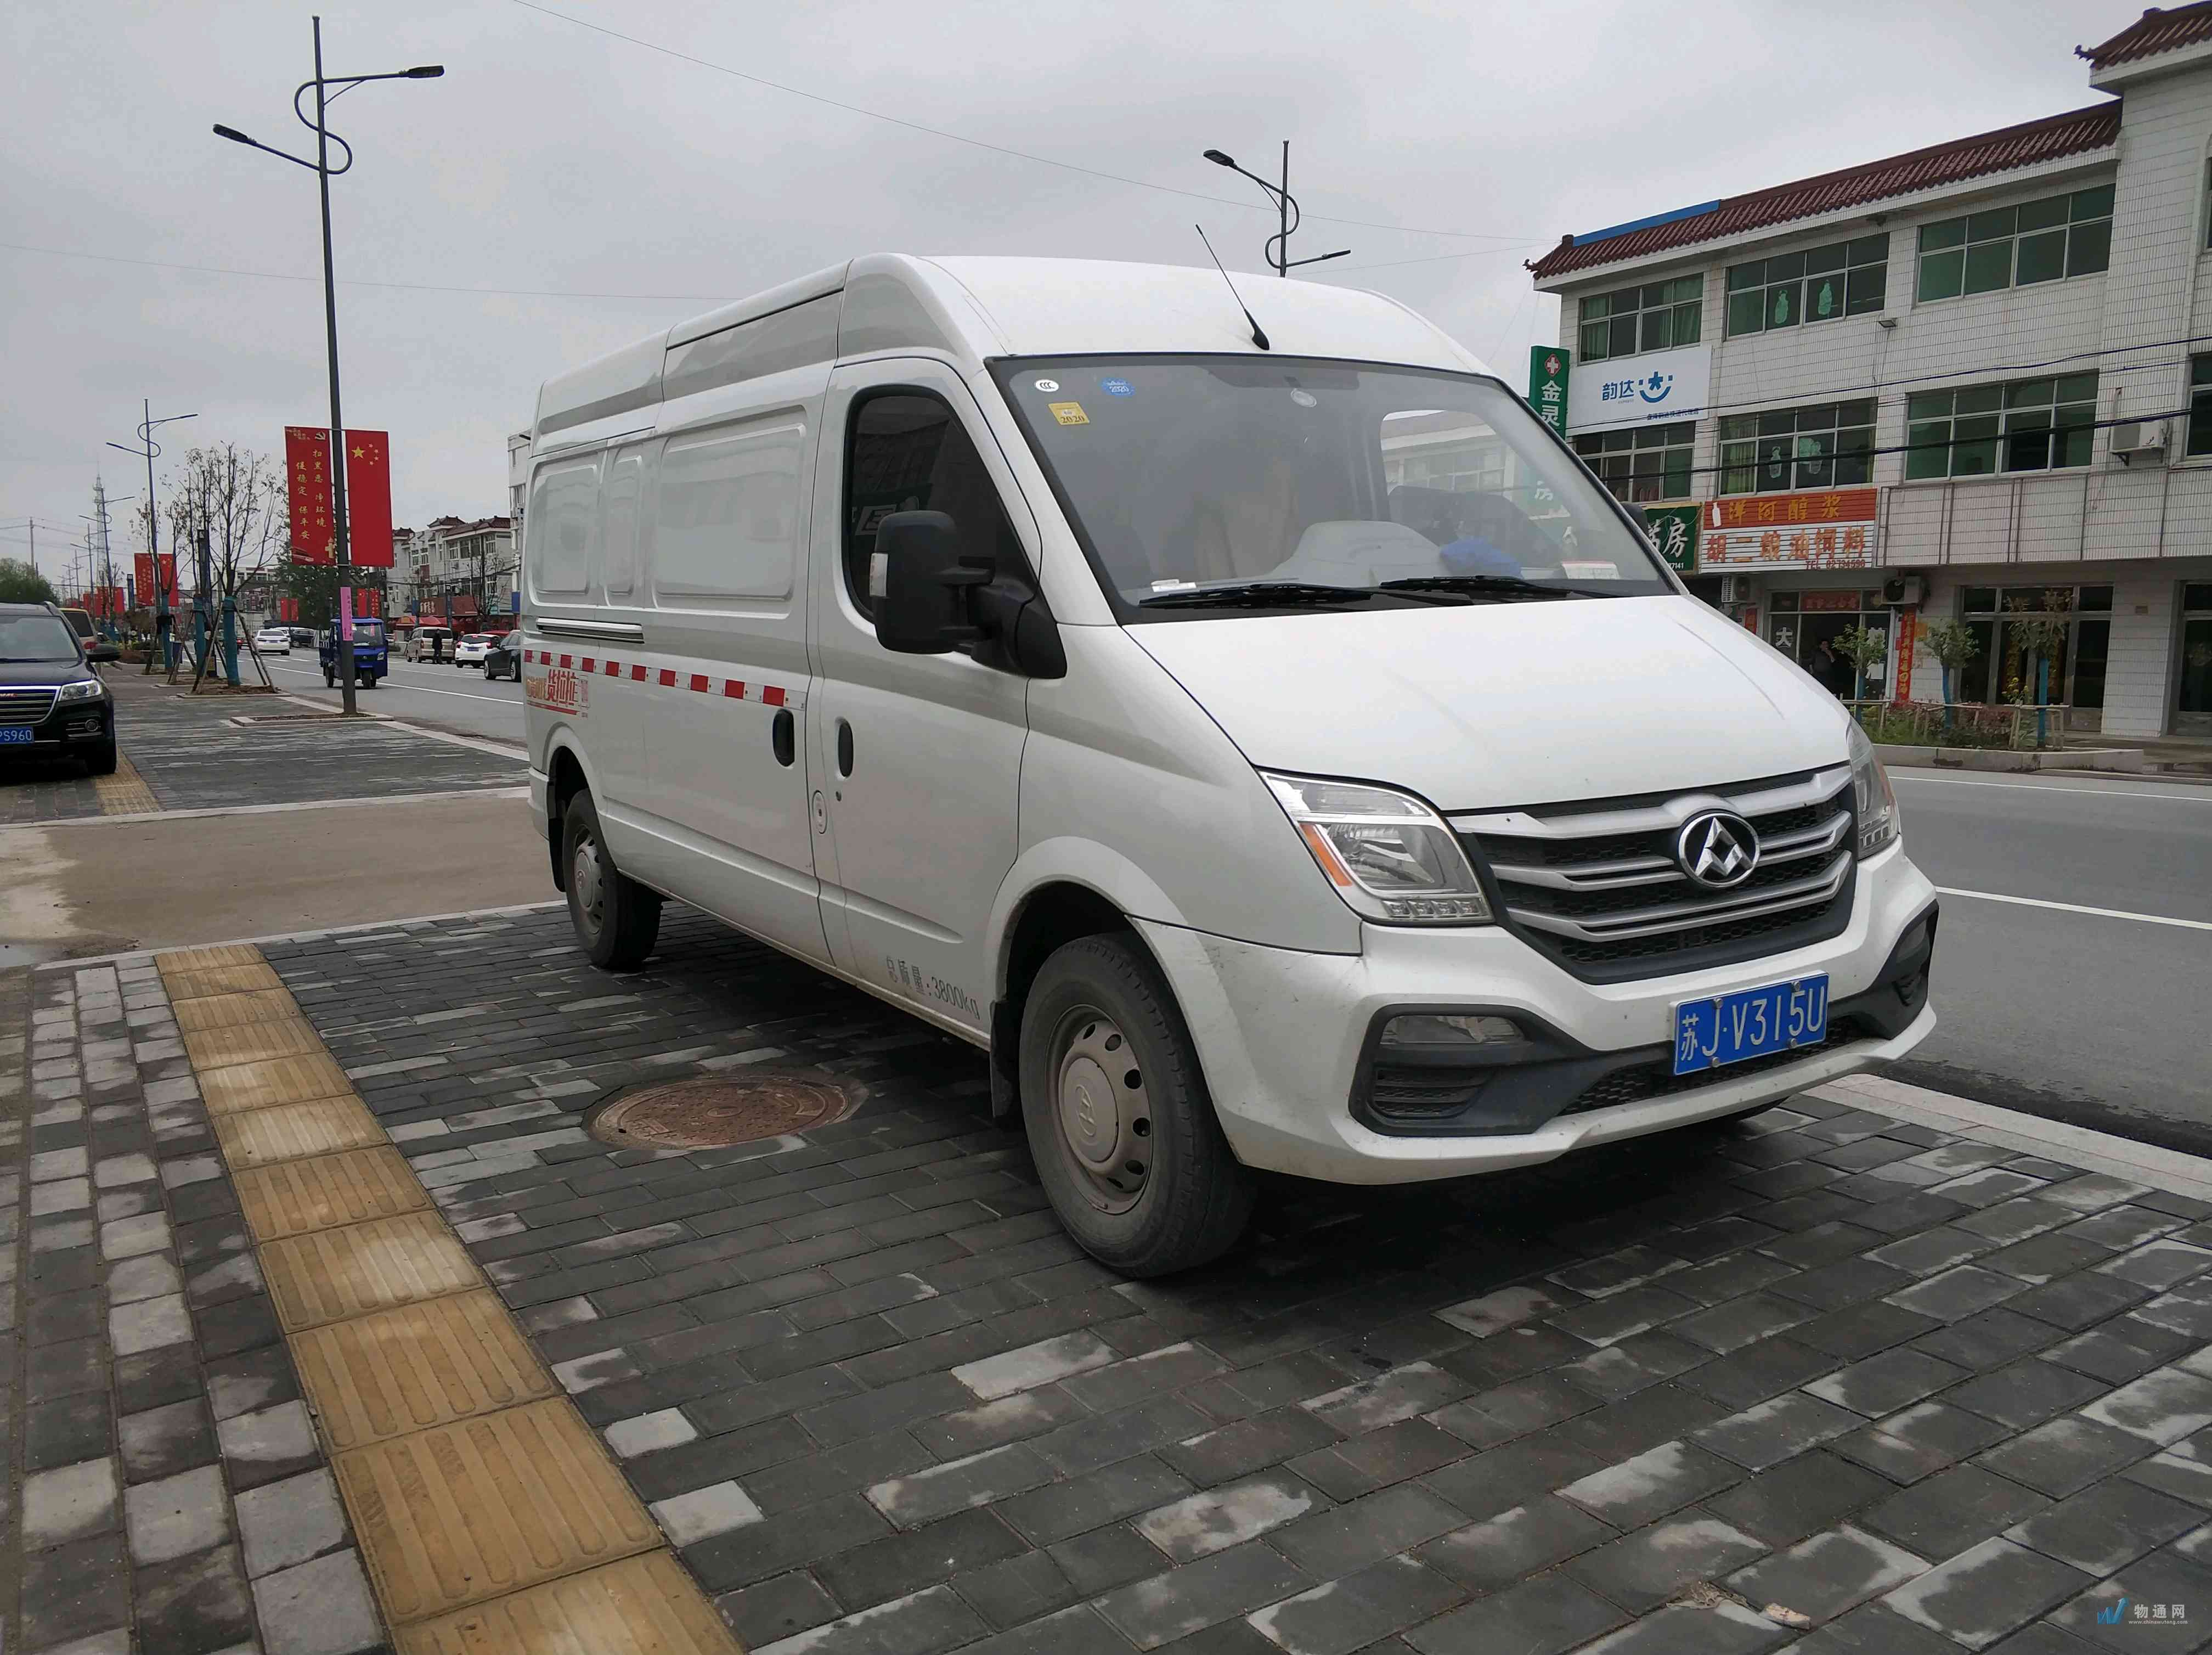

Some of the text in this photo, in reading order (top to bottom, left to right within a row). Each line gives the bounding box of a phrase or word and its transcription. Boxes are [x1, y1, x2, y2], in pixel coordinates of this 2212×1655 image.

[1541, 380, 1562, 426] 金灵
[1602, 379, 1634, 401] 韵达
[1060, 415, 1085, 424] 2020
[298, 505, 311, 540] 保平安
[1707, 525, 1865, 562] 胡二粮油饲料
